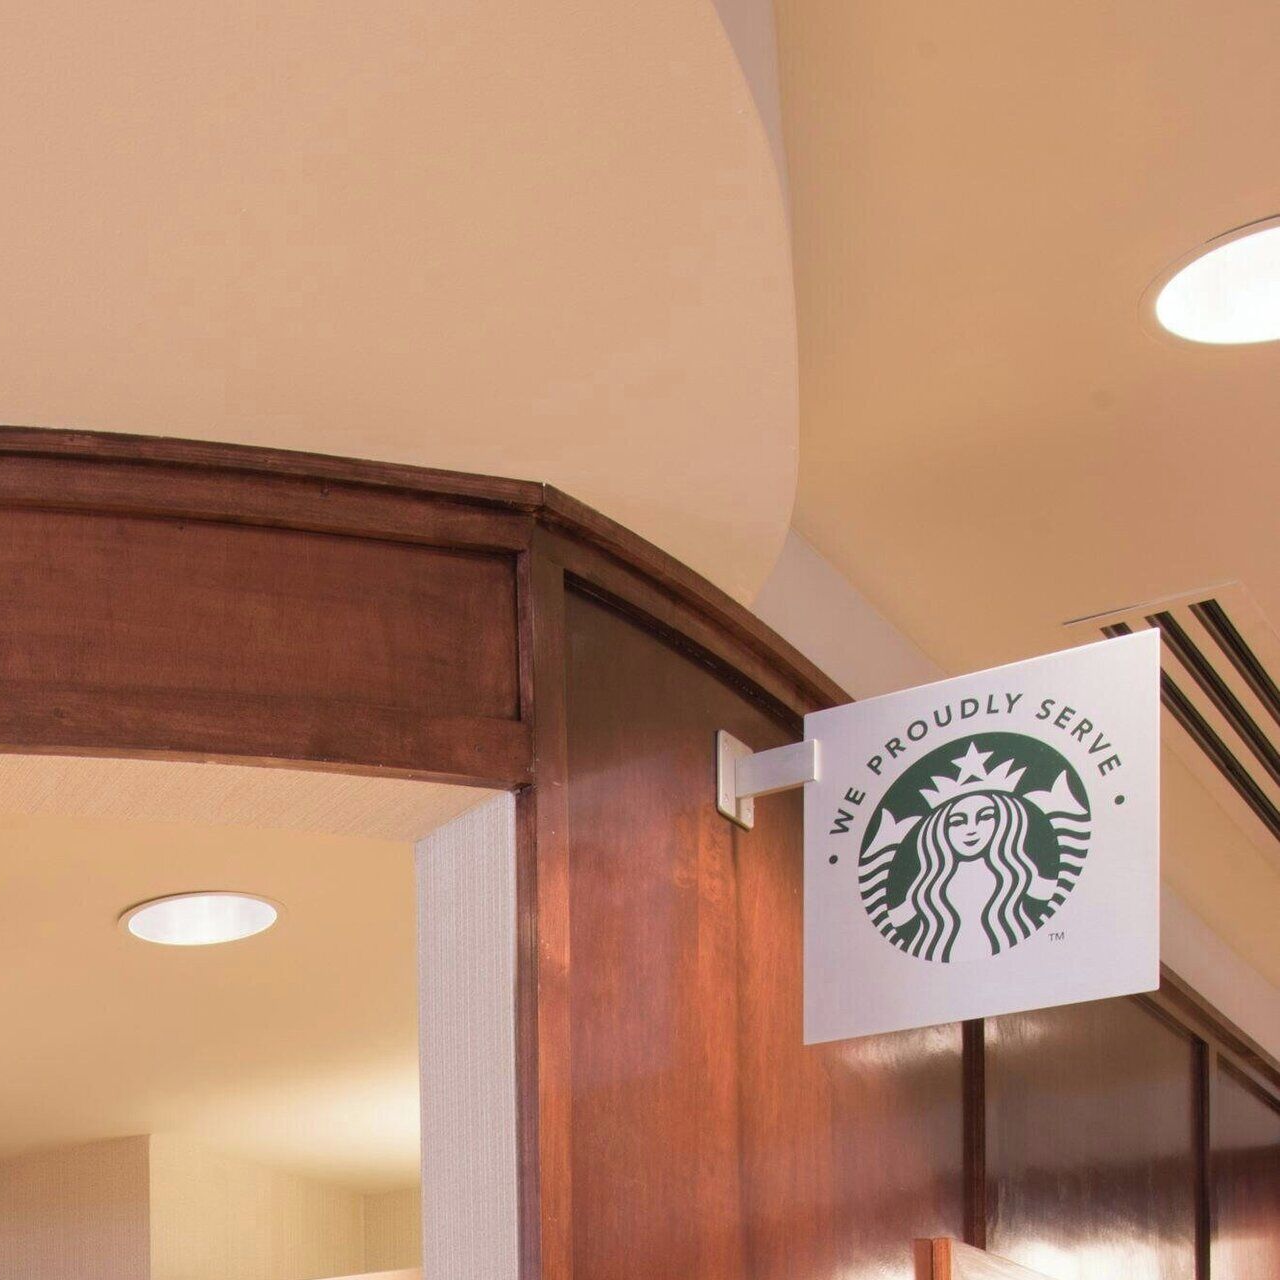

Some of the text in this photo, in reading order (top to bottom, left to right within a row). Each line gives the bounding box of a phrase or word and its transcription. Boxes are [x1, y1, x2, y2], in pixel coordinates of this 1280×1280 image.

[830, 692, 1122, 835] WE PROUDLY SERVE
